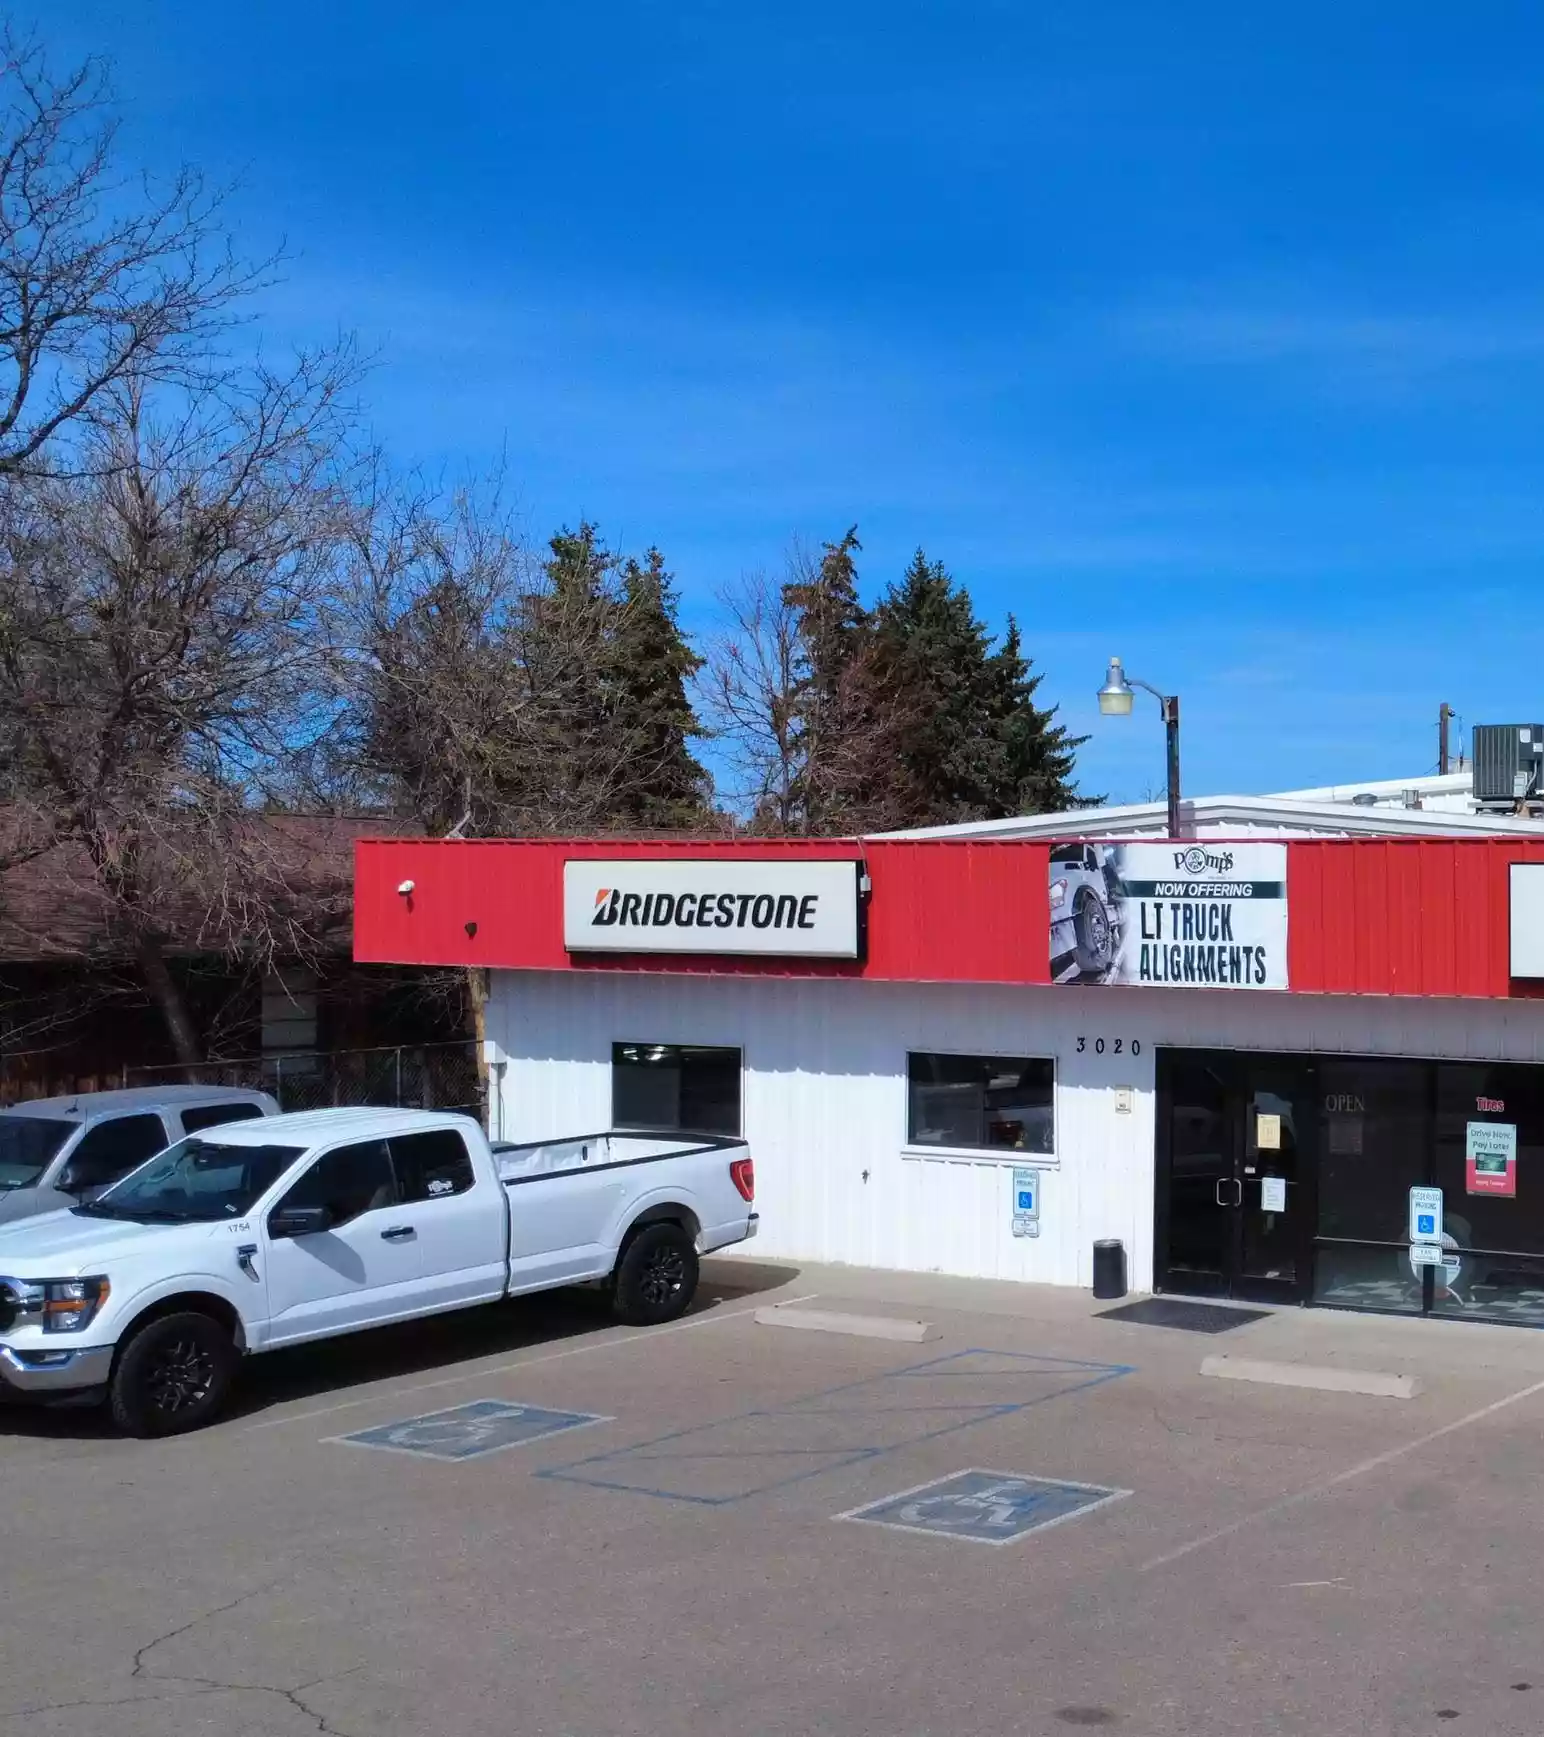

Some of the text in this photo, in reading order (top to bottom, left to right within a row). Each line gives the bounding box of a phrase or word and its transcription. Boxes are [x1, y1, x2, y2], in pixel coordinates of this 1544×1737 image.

[1154, 883, 1253, 898] NOW OFFERING
[591, 888, 819, 929] BRIDGESTONE
[1140, 901, 1233, 942] LT TRUCK
[1139, 943, 1267, 985] ALIGNMENTS
[1076, 1036, 1141, 1056] 3020
[1325, 1093, 1365, 1113] OPEN
[1475, 1096, 1505, 1113] Tires
